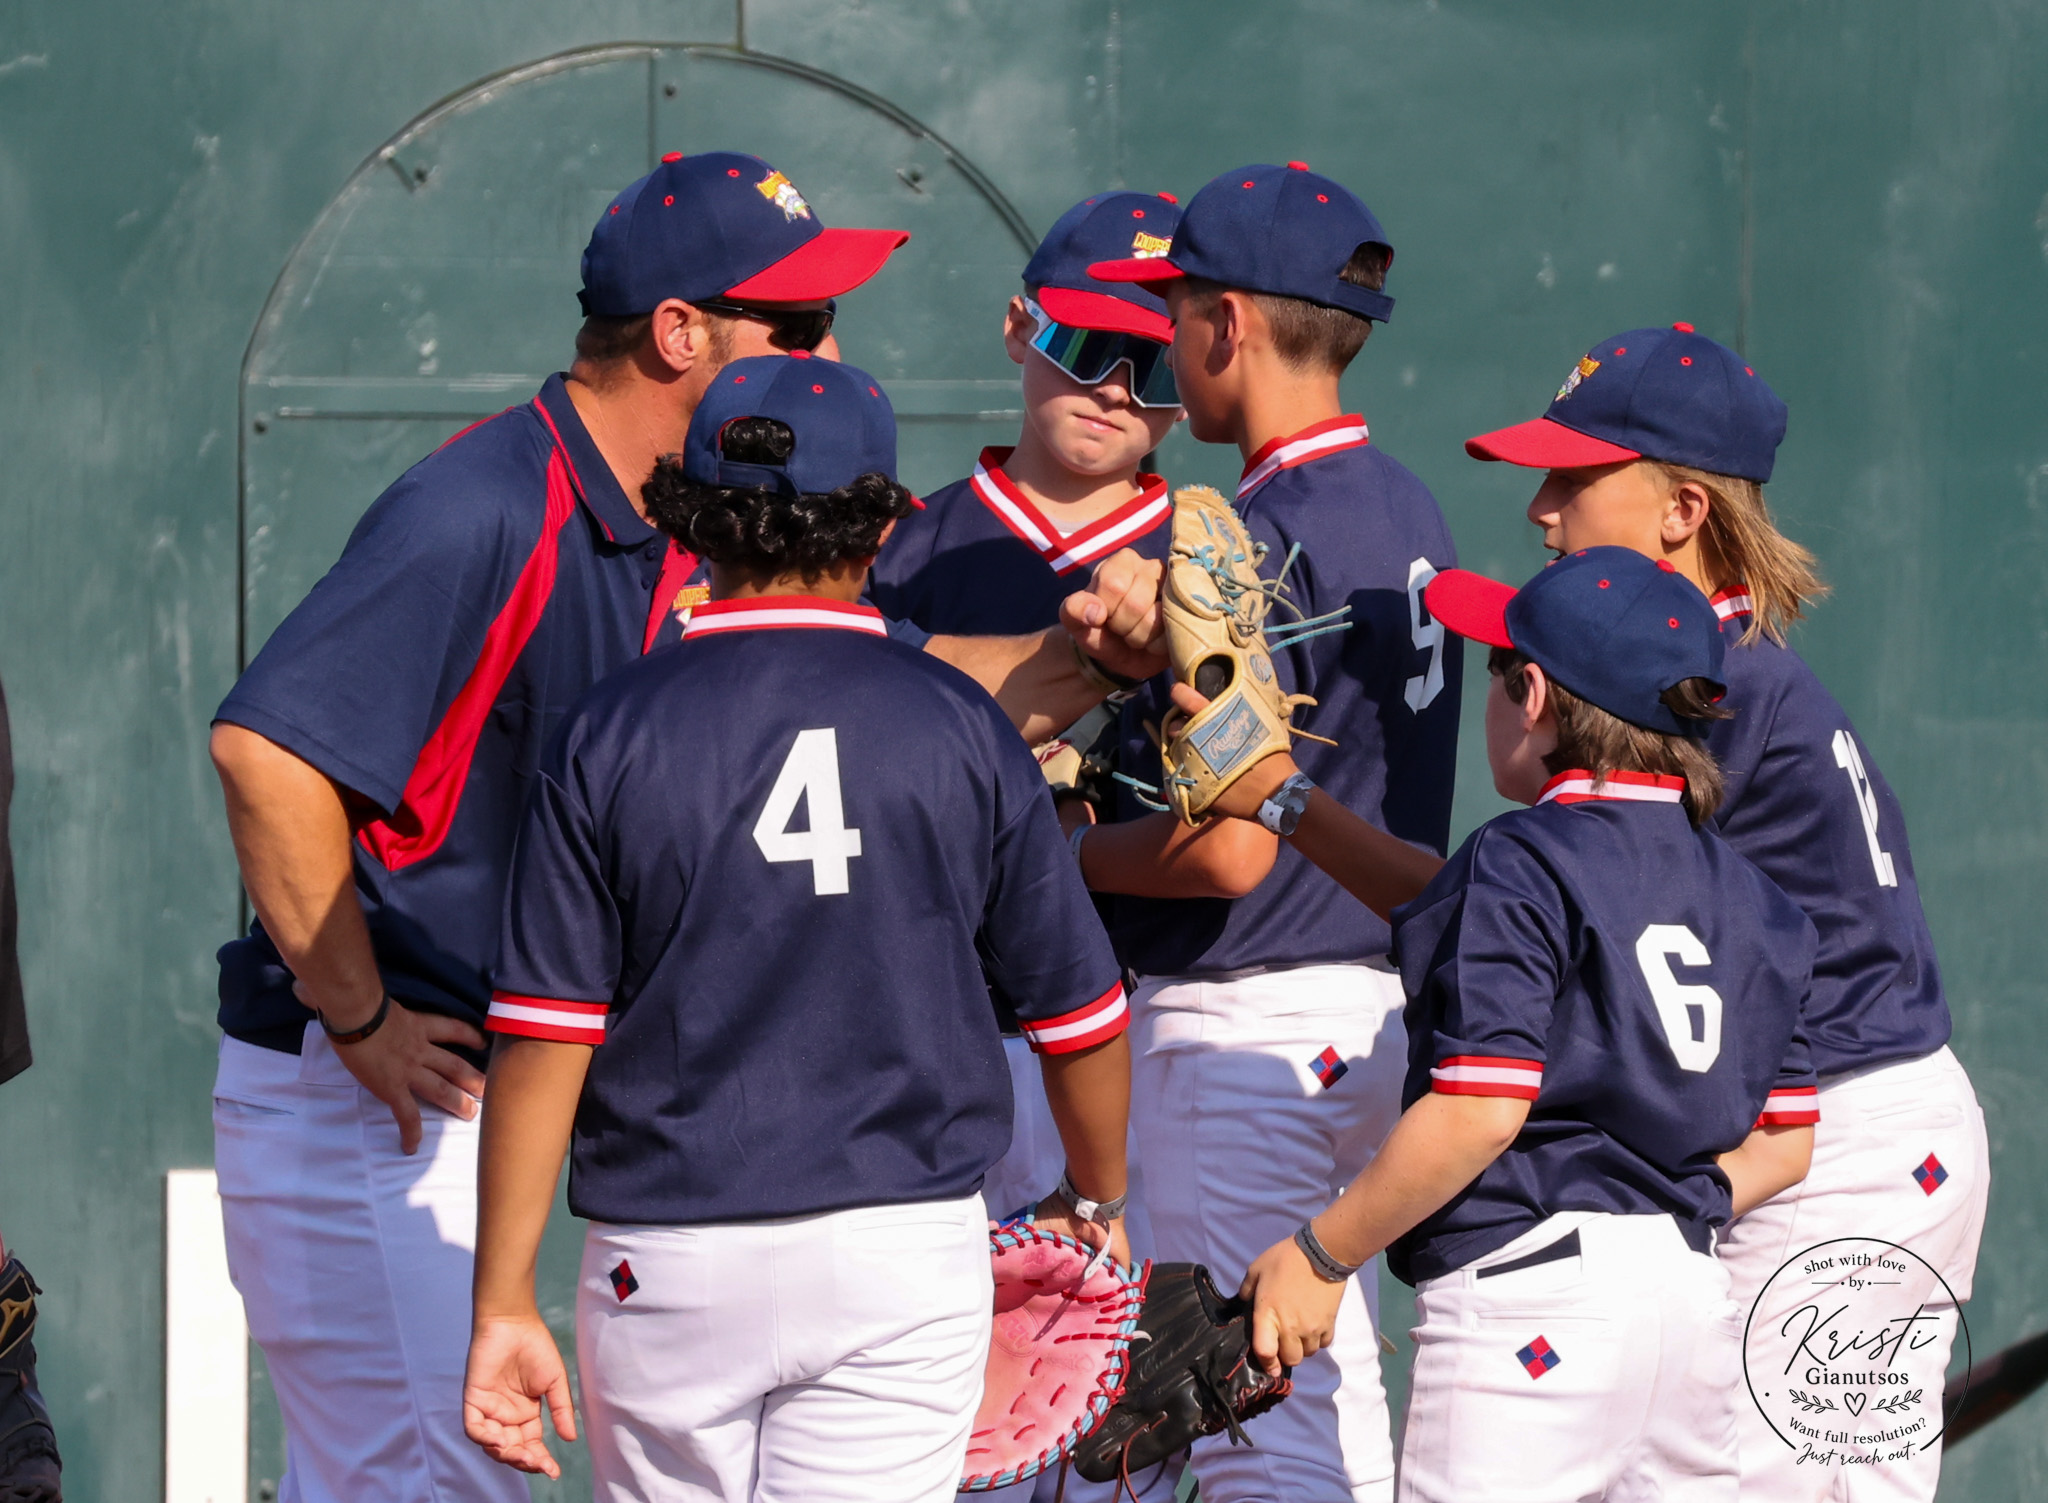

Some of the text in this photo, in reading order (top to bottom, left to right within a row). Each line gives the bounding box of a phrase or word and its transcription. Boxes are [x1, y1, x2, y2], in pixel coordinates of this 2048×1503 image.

[1403, 556, 1446, 716] 9
[752, 727, 862, 896] 4
[1208, 709, 1251, 759] Rawlings
[1831, 729, 1898, 887] 12
[1635, 923, 1723, 1073] 6
